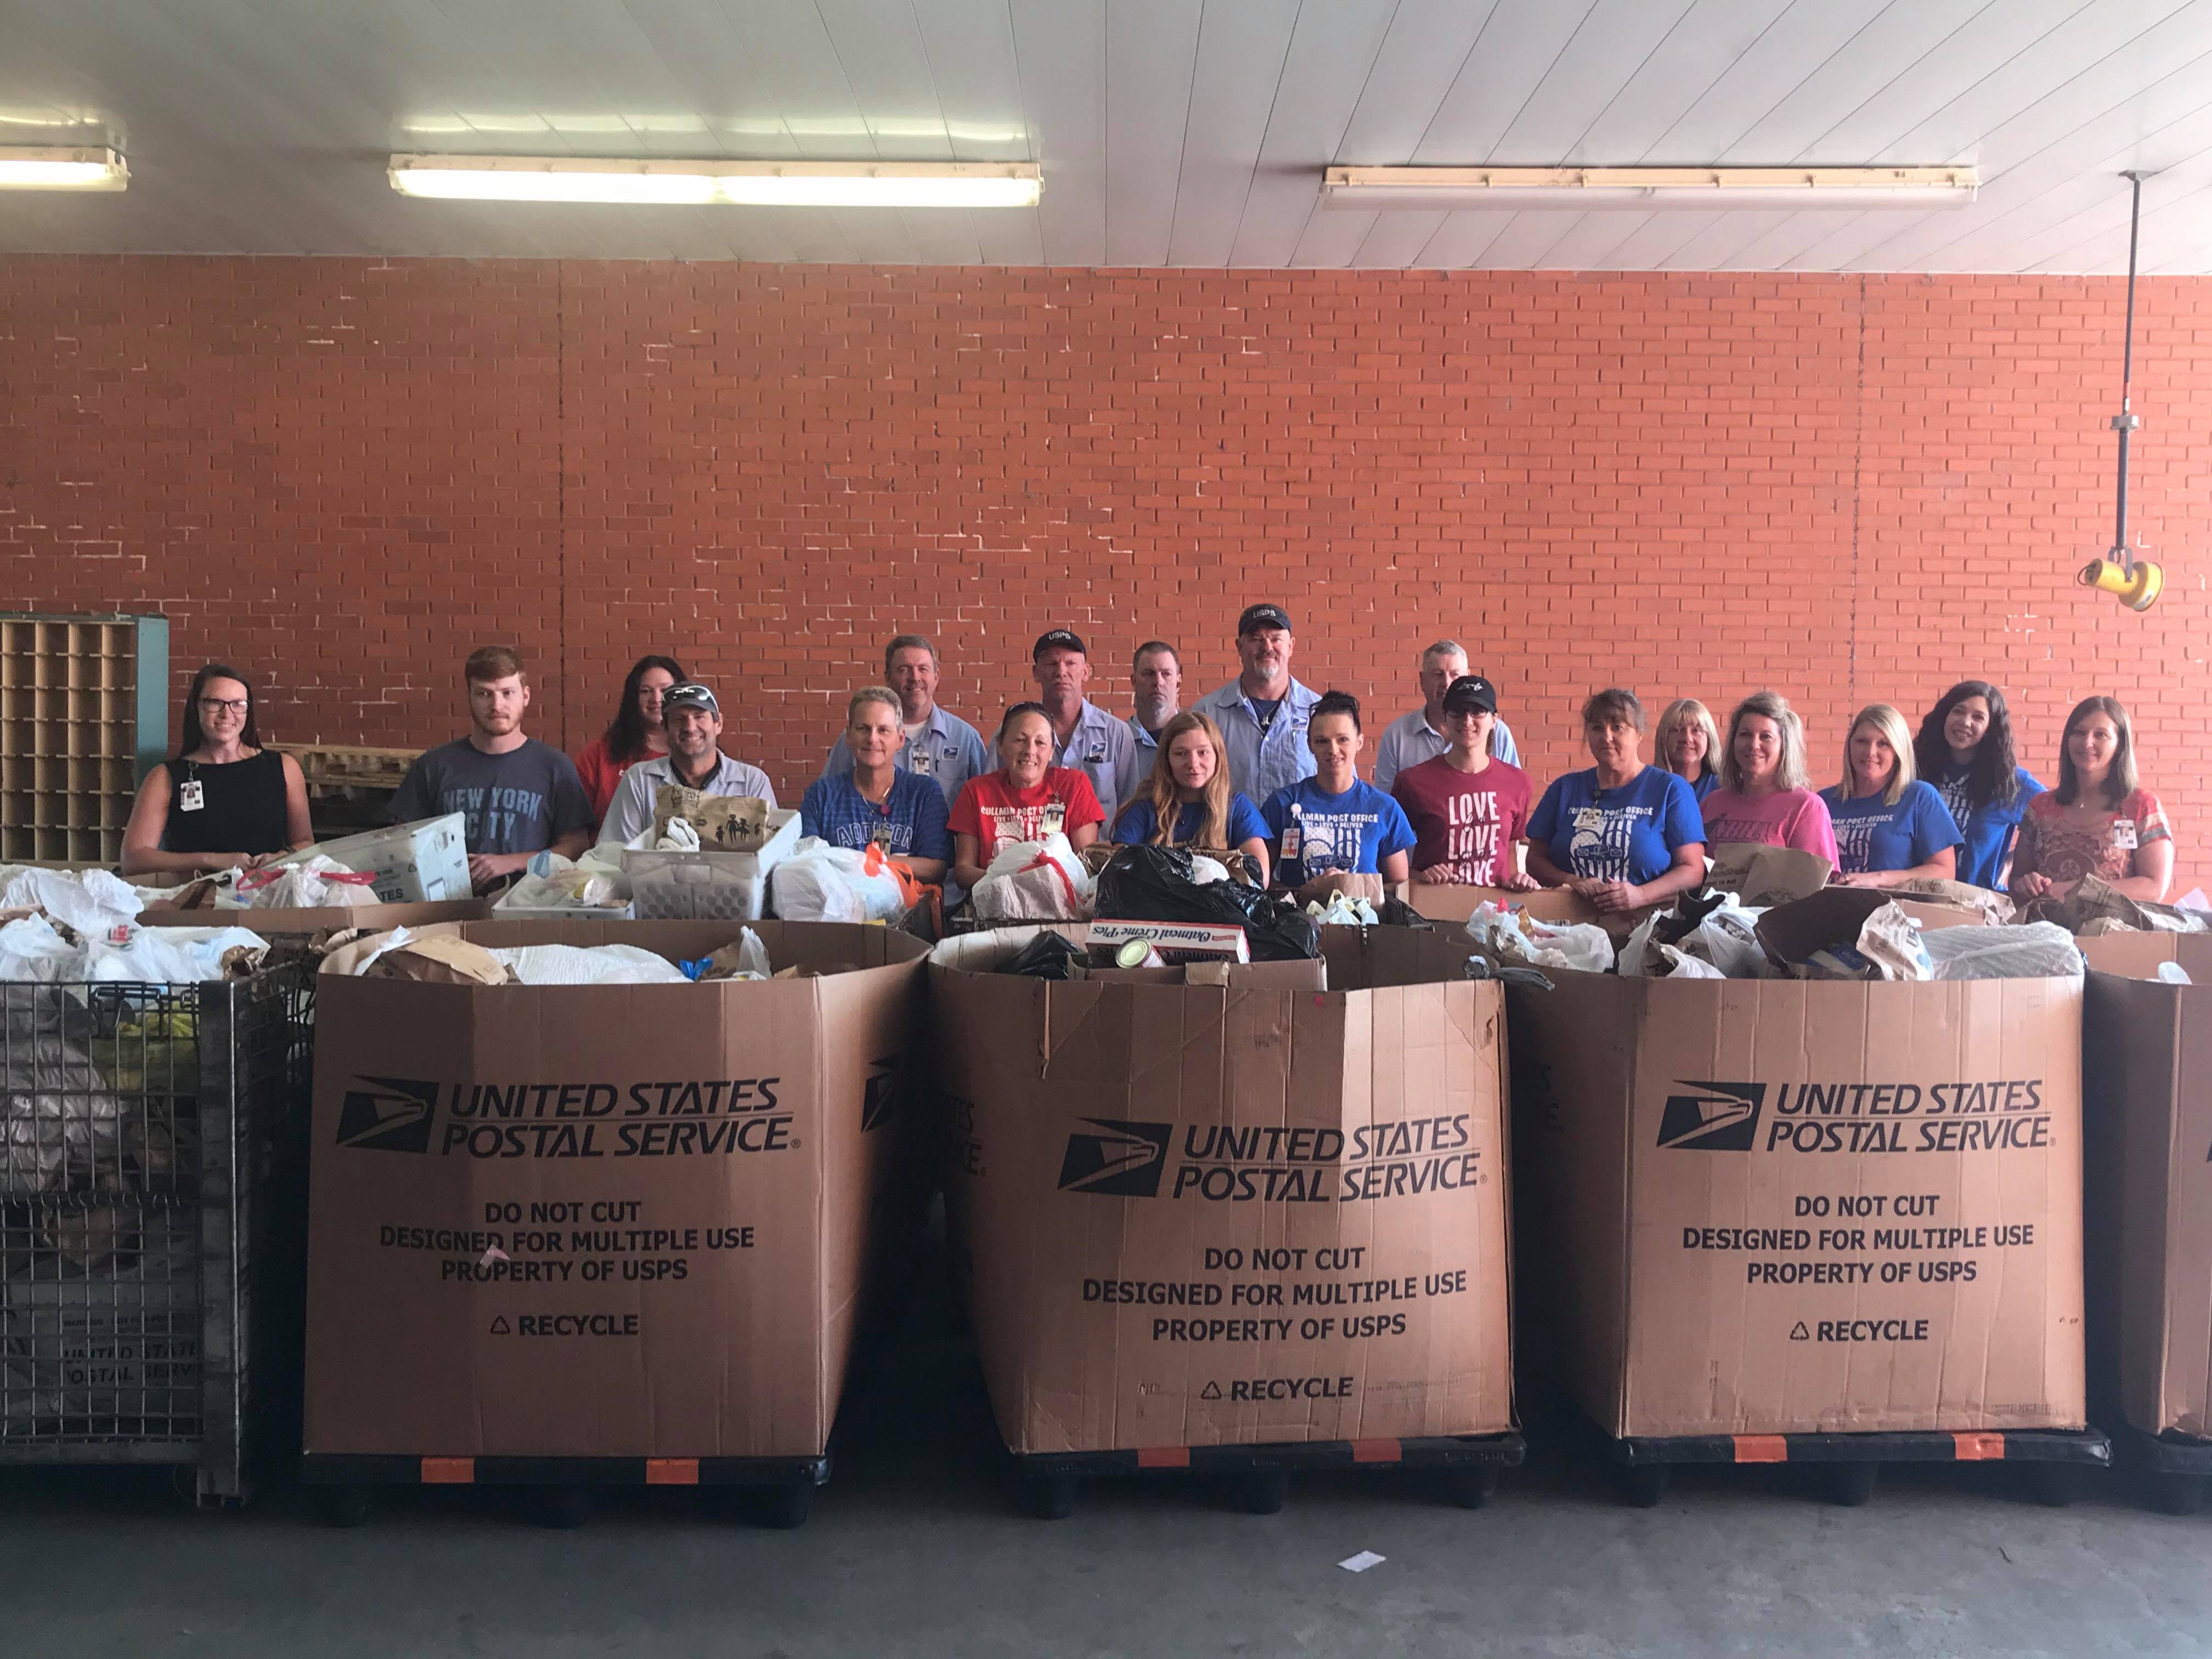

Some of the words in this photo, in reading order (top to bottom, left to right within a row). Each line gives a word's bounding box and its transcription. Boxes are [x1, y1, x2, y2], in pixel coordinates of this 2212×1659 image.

[1048, 631, 1071, 640] USPS
[443, 788, 484, 813] NEW
[492, 787, 543, 821] YORK
[1017, 806, 1037, 816] POST
[1448, 791, 1500, 825] LOVE
[1626, 806, 1654, 816] OFFICE
[1327, 814, 1349, 823] POST
[1351, 813, 1379, 823] OFFICE
[1448, 823, 1501, 860] LOVE
[1093, 926, 1120, 938] Pies
[1120, 927, 1159, 941] Creme
[1159, 929, 1211, 943] Oatmeal
[450, 1083, 619, 1119] UNITED
[624, 1077, 781, 1116] STATES
[1776, 1082, 1922, 1115] UNITED
[1926, 1079, 2043, 1114] STATES
[442, 1123, 605, 1159] POSTAL
[1183, 1124, 1345, 1162] UNITED
[1348, 1113, 1471, 1160] STATES
[1766, 1120, 1908, 1153] POSTAL
[1172, 1166, 1331, 1203] POSTAL
[485, 1202, 522, 1223] DO
[530, 1201, 584, 1223] NOT
[590, 1201, 641, 1223] CUT
[1795, 1196, 1830, 1217] DO
[1837, 1195, 1888, 1217] NOT
[1893, 1195, 1940, 1216] CUT
[380, 1225, 504, 1253] DESIGNED
[512, 1231, 562, 1253] FOR
[571, 1229, 699, 1253] MULTIPLE
[706, 1226, 755, 1248] USE
[1683, 1227, 1811, 1250] DESIGNED
[1819, 1229, 1865, 1250] FOR
[1873, 1227, 1987, 1250] MULTIPLE
[1993, 1224, 2034, 1245] USE
[441, 1259, 573, 1283] PROPERTY
[581, 1260, 616, 1281] OF
[622, 1259, 689, 1280] USPS
[1205, 1248, 1243, 1271] DO
[1252, 1248, 1308, 1270] NOT
[1315, 1246, 1366, 1270] CUT
[1747, 1262, 1874, 1284] PROPERTY
[1881, 1262, 1912, 1283] OF
[1918, 1261, 1977, 1282] USPS
[1082, 1279, 1223, 1307] DESIGNED
[1231, 1283, 1285, 1307] FOR
[1292, 1277, 1418, 1306] MULTIPLE
[1424, 1269, 1467, 1297] USE
[519, 1314, 639, 1336] RECYCLE
[1152, 1318, 1292, 1341] PROPERTY
[1300, 1318, 1335, 1340] OF
[1341, 1313, 1407, 1338] USPS
[1817, 1319, 1929, 1342] RECYCLE
[1230, 1376, 1354, 1401] RECYCLE
